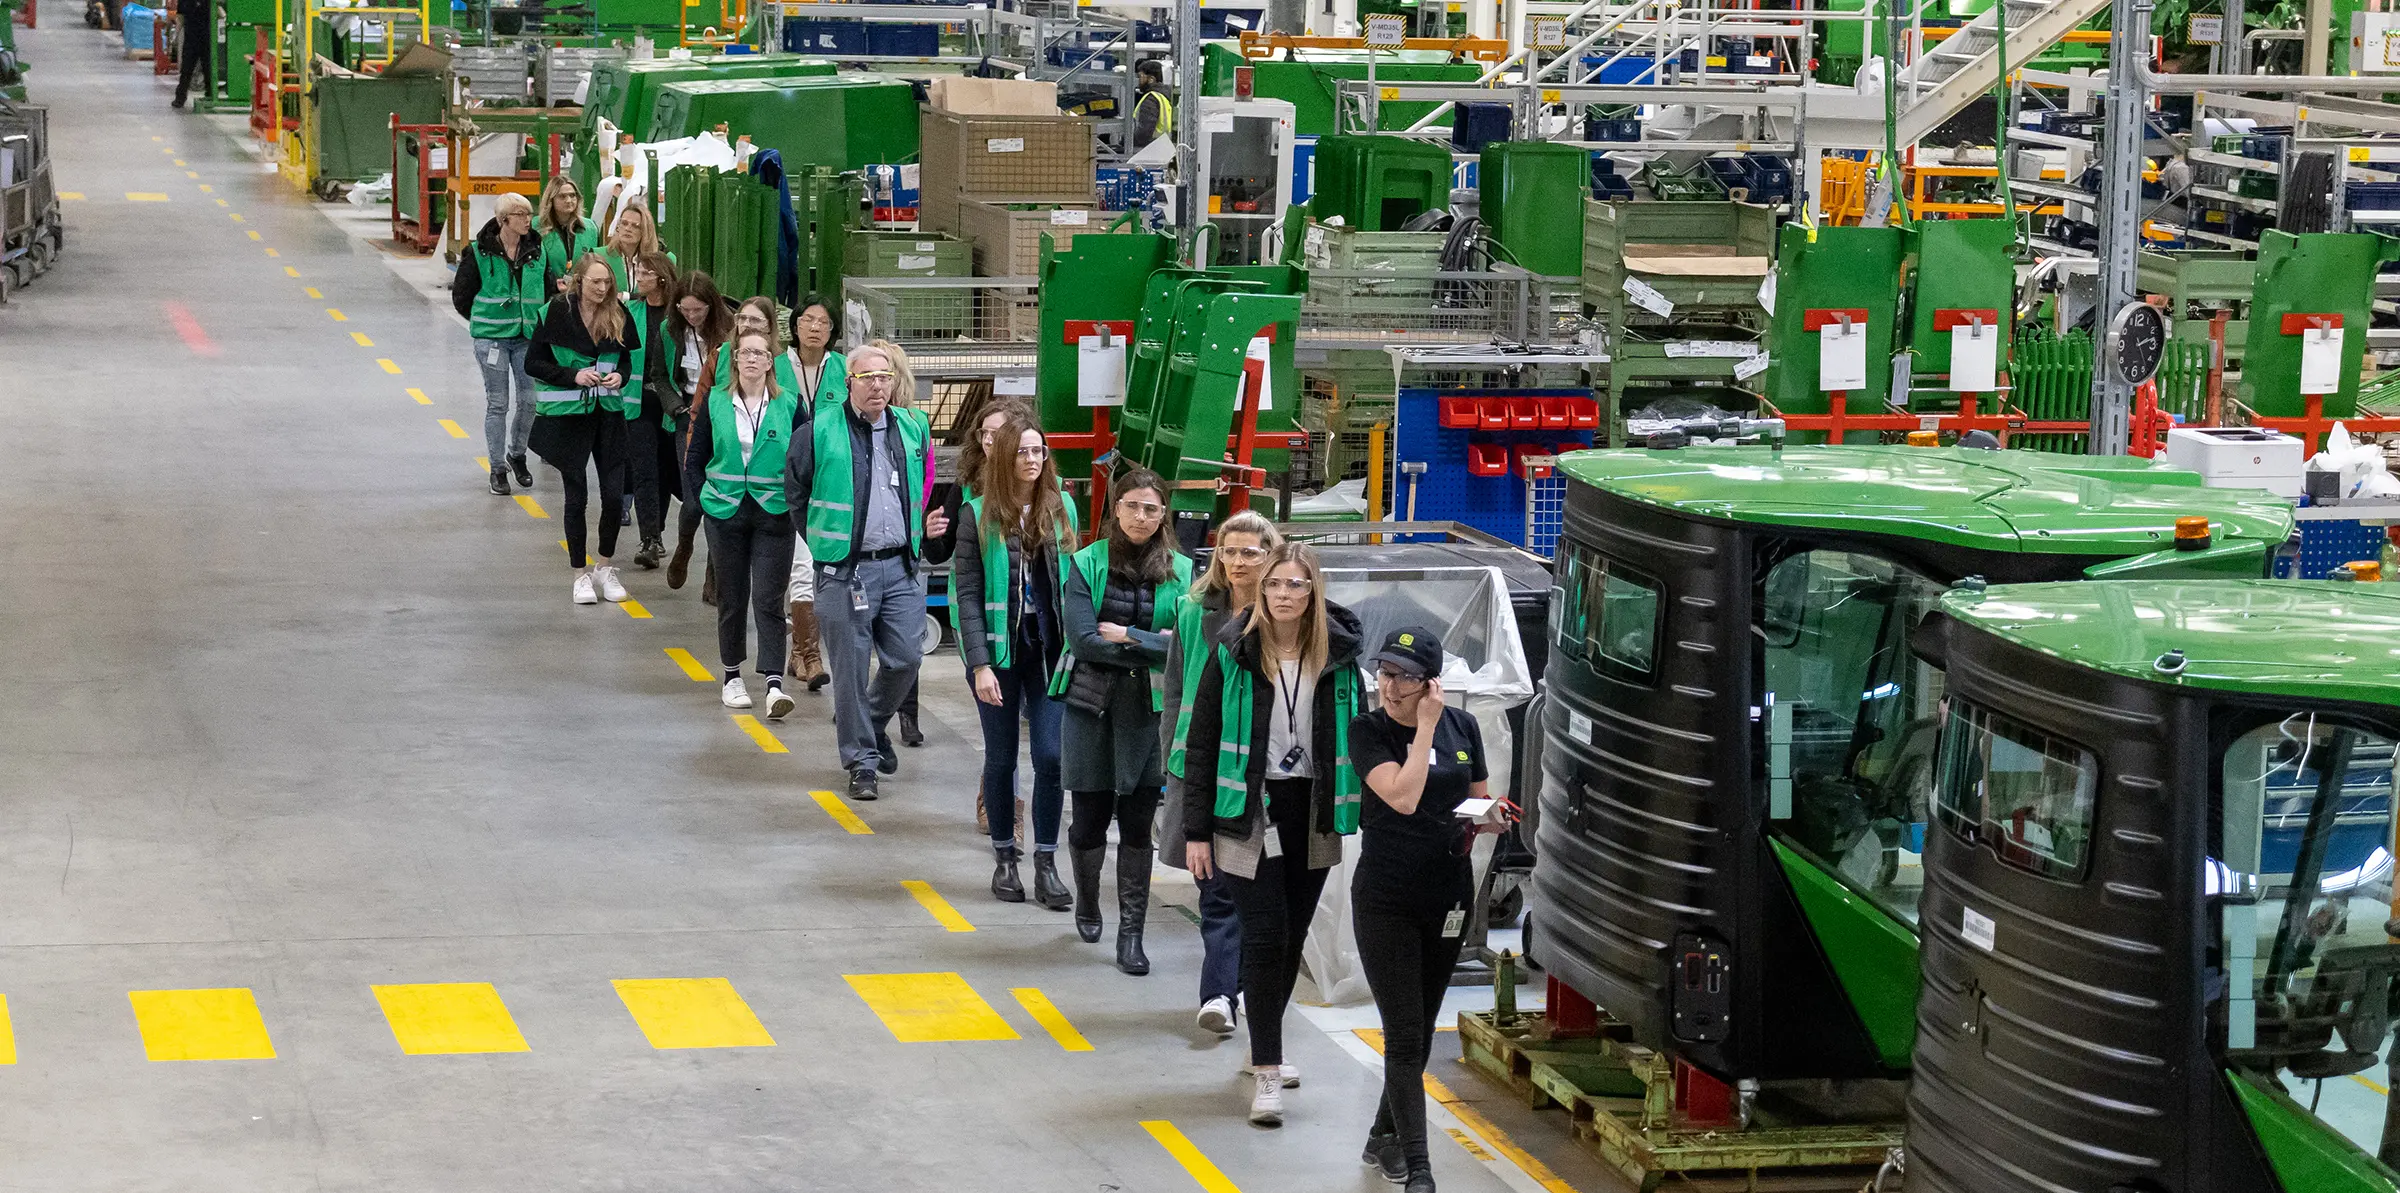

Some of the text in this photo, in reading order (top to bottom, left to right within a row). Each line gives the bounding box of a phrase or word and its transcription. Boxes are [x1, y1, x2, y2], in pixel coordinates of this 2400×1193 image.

[1371, 23, 1401, 31] V-MD35L
[2135, 313, 2144, 327] 12
[2150, 326, 2155, 335] 2
[2118, 339, 2125, 352] 9
[2149, 337, 2157, 351] 3
[2119, 356, 2124, 364] 8
[2123, 366, 2128, 374] 7
[2131, 365, 2138, 377] 6
